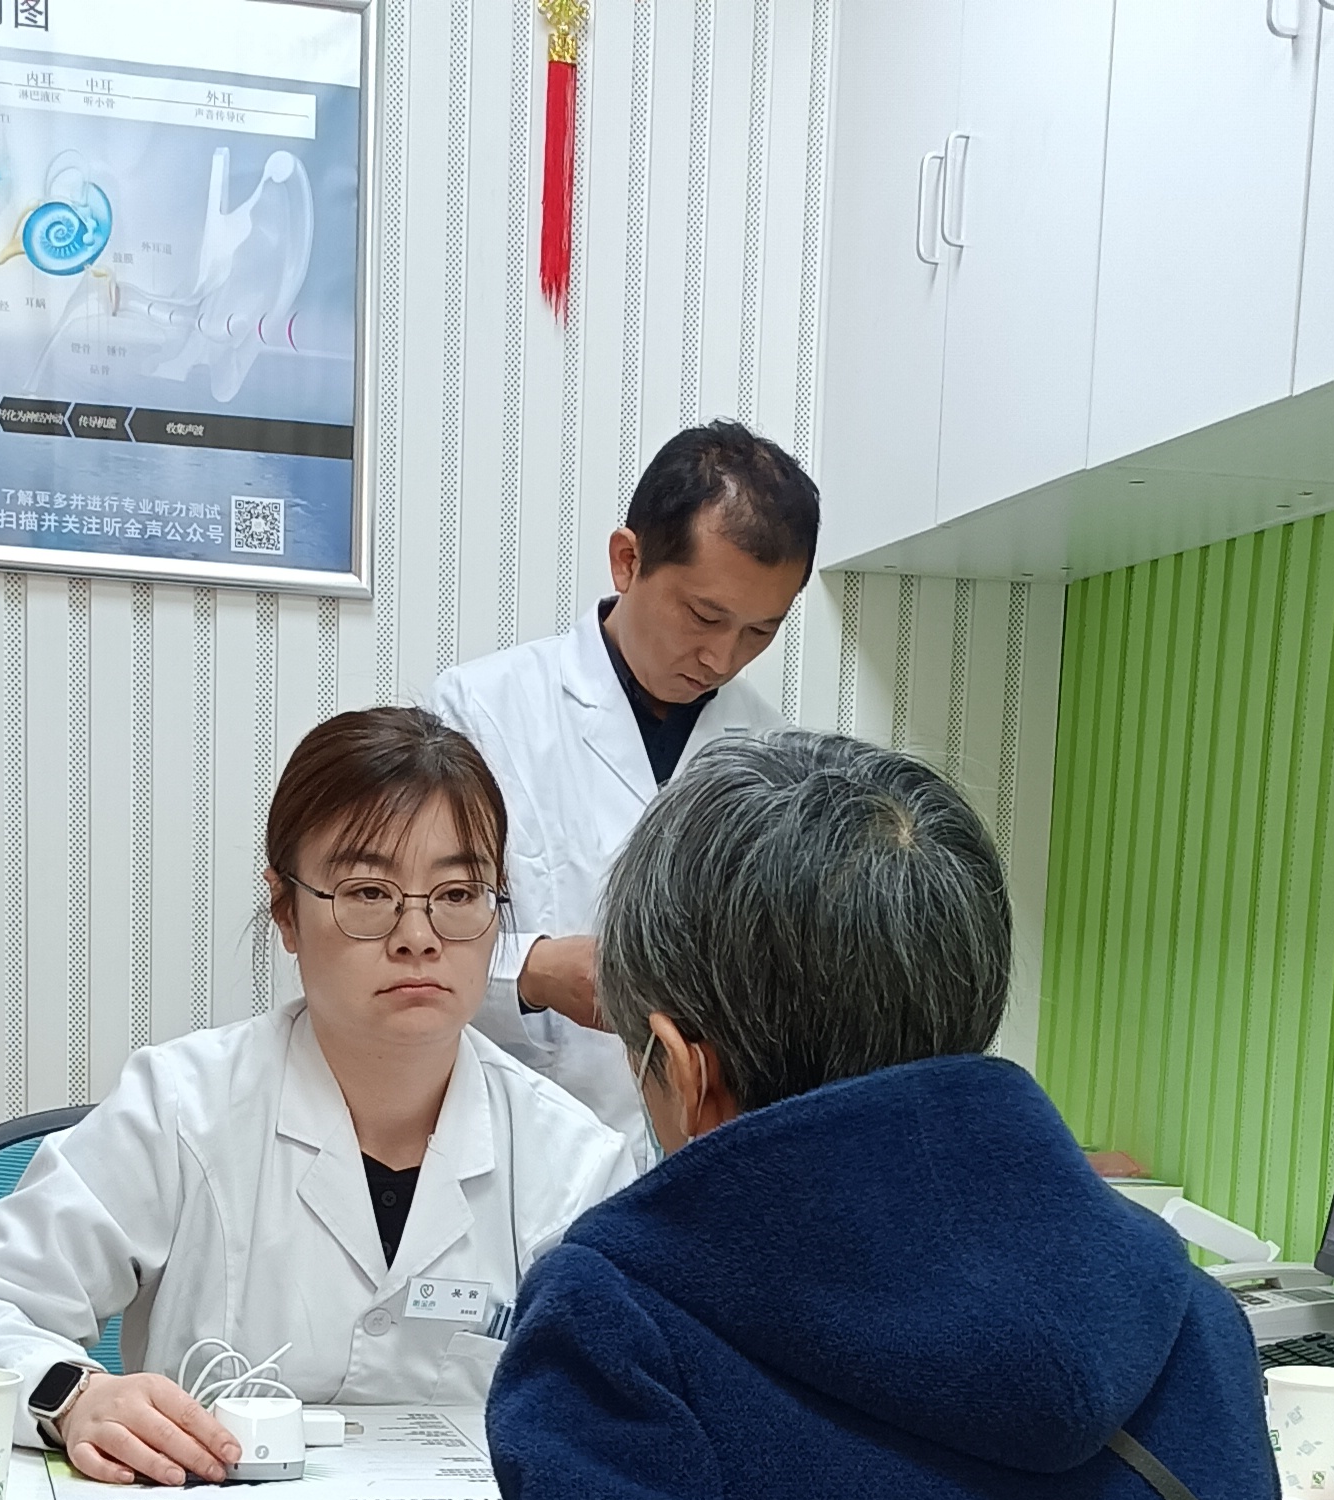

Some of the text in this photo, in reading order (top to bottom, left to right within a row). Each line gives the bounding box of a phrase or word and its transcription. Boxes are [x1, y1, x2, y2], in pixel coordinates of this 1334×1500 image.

[26, 71, 55, 88] 内耳
[85, 77, 113, 93] 中耳
[18, 88, 61, 105] 淋巴液区
[83, 95, 116, 110] 听小骨
[206, 90, 233, 107] 外耳
[194, 107, 246, 124] 声音传导区
[78, 414, 116, 430] 传导机能
[166, 421, 204, 438] 收集声波
[1, 488, 221, 520] 了解更多并进行专业听力测试
